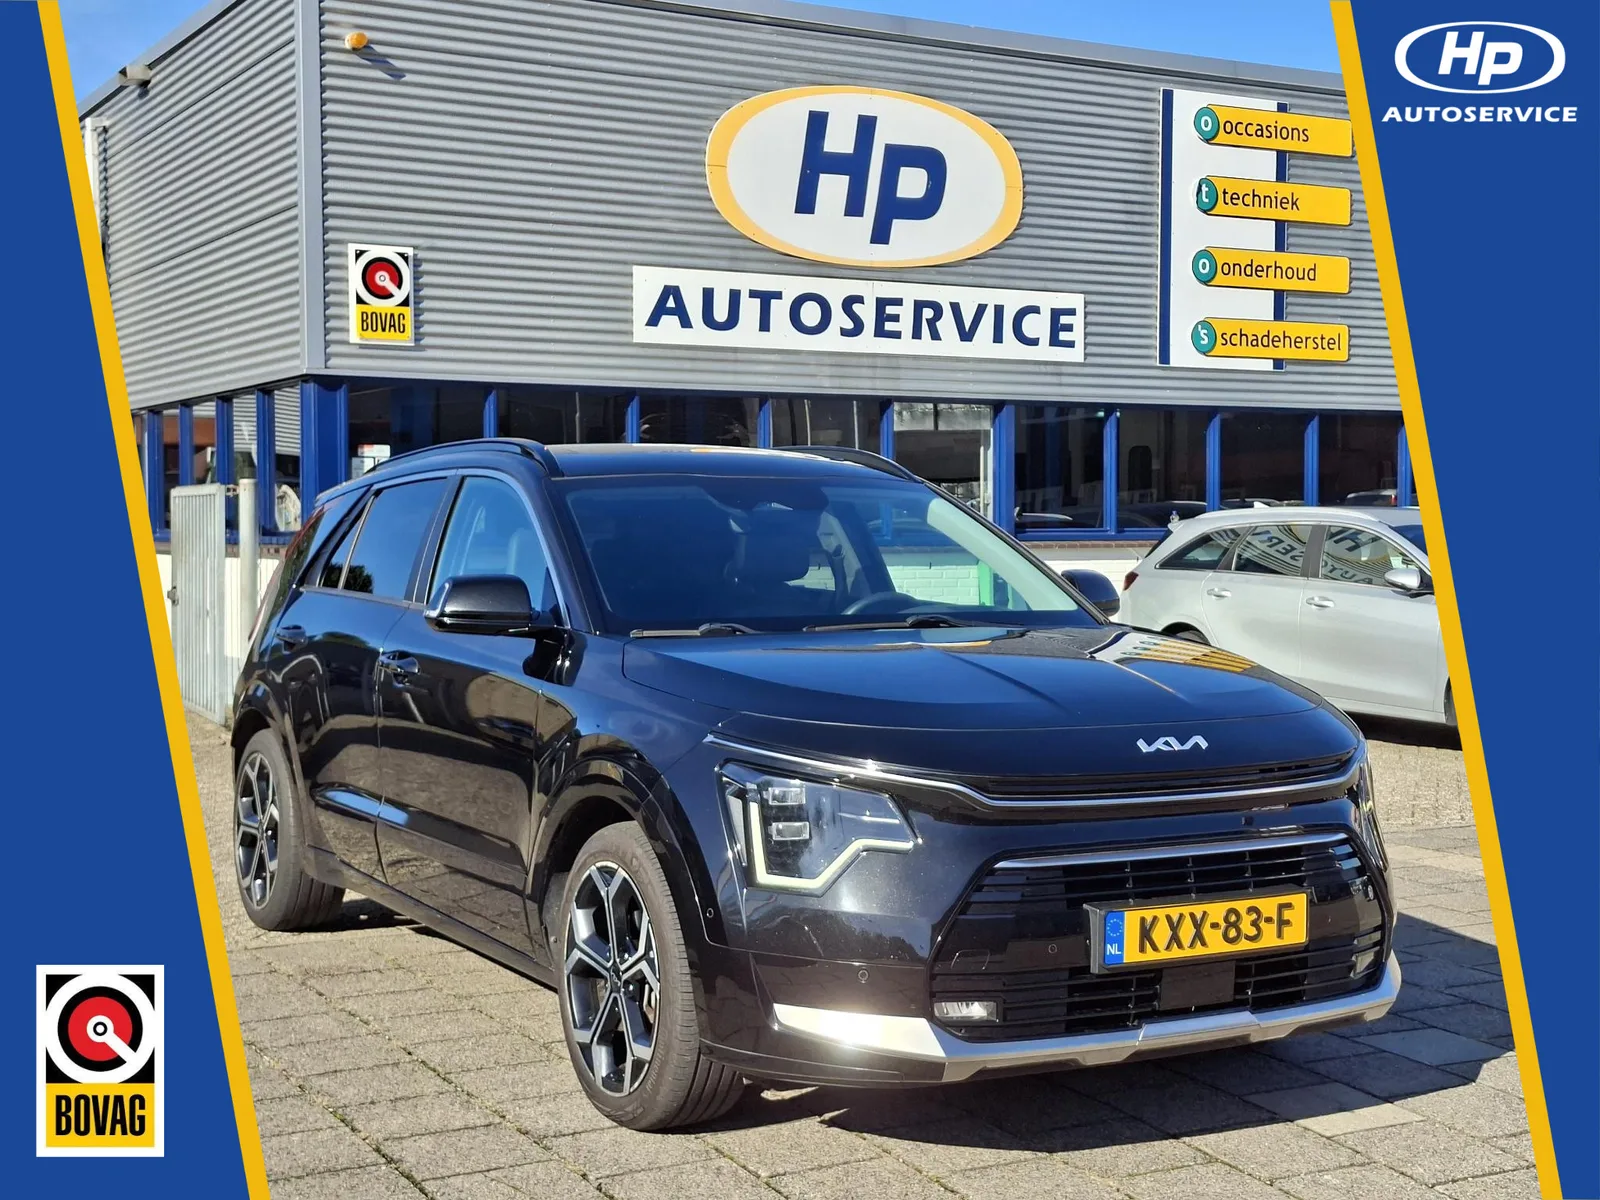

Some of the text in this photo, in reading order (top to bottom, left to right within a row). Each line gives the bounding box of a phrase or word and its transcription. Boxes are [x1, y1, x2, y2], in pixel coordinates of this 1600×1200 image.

[1222, 118, 1310, 143] occasions
[794, 109, 948, 245] Hp
[1221, 187, 1300, 212] techniek
[1220, 258, 1317, 282] onderhoud
[361, 311, 406, 334] BOVAG
[645, 284, 1078, 348] AUTOSERVICE
[1220, 328, 1341, 352] schadeherstel
[1136, 735, 1209, 753] KIA
[1138, 901, 1295, 954] KXX-83-F
[1106, 943, 1121, 955] NL
